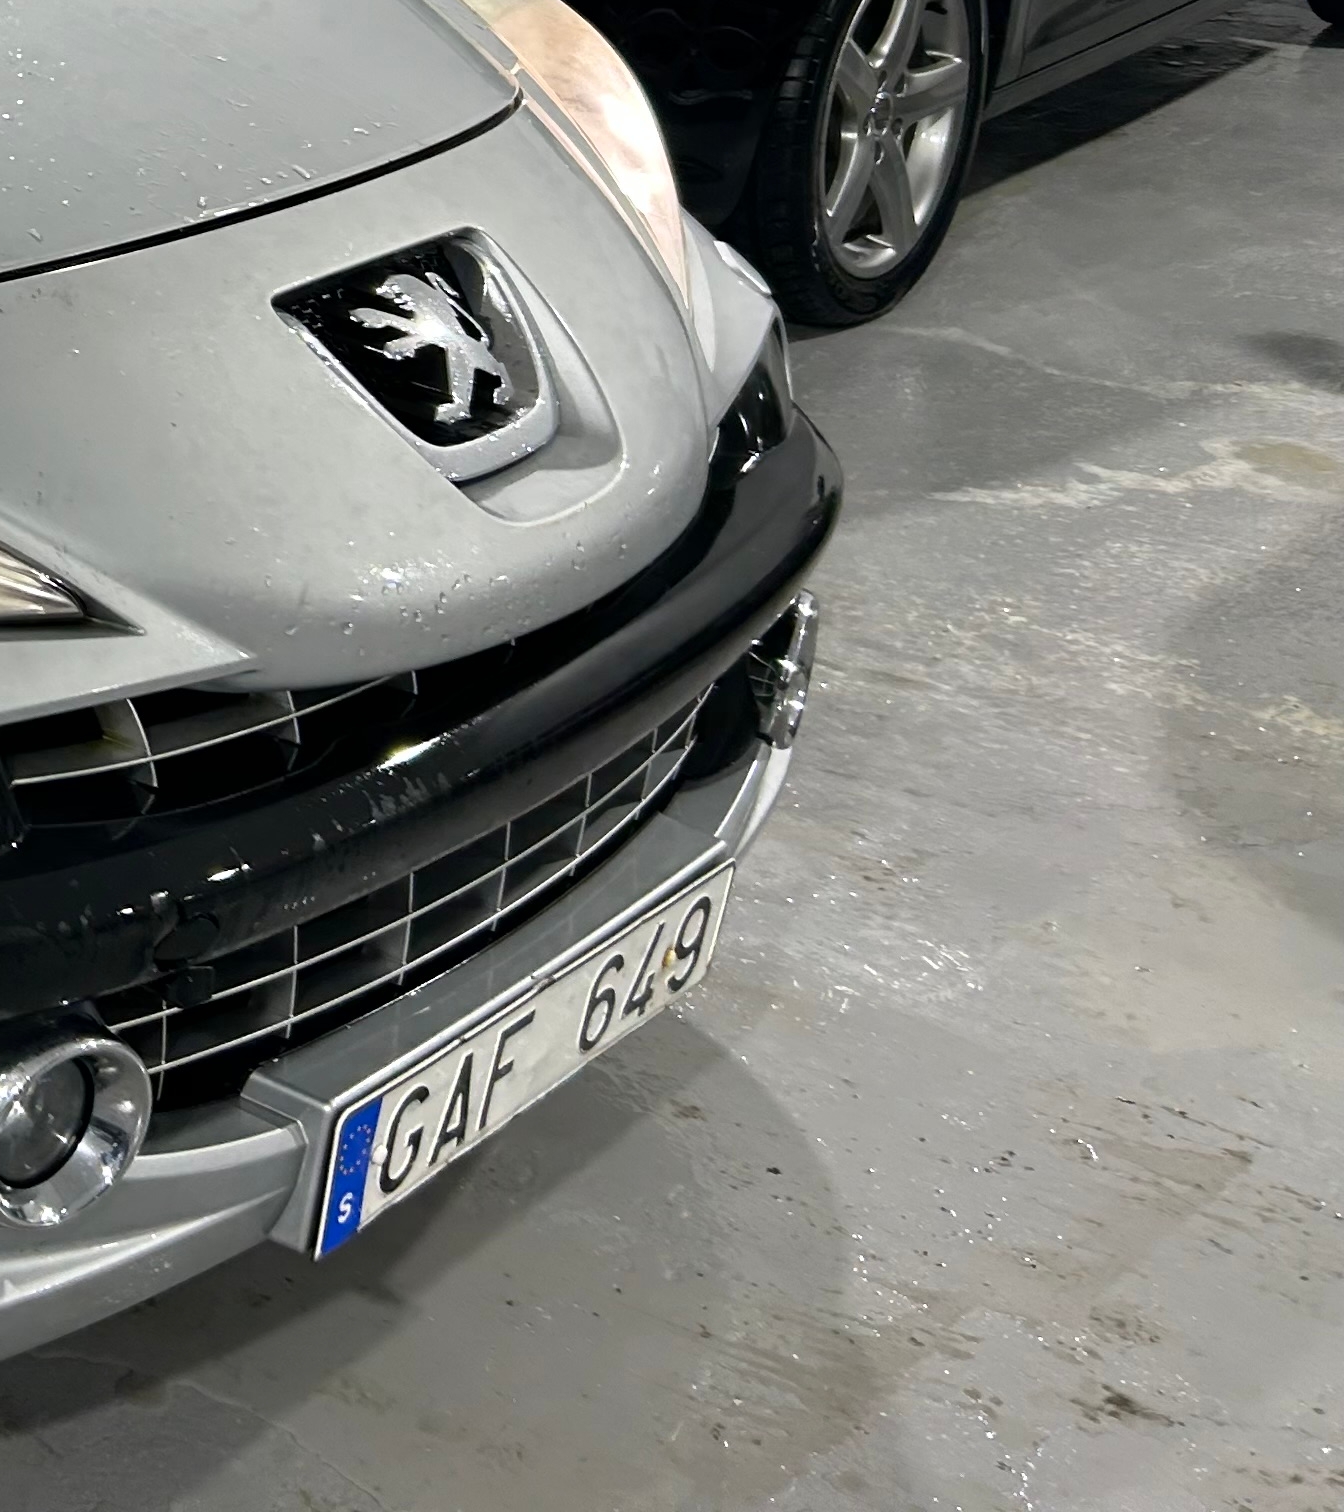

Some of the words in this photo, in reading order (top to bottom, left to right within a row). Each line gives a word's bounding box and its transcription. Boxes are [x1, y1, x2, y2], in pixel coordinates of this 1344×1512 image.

[379, 1010, 537, 1195] GAF
[578, 895, 712, 1054] 649
[336, 1190, 354, 1225] S
